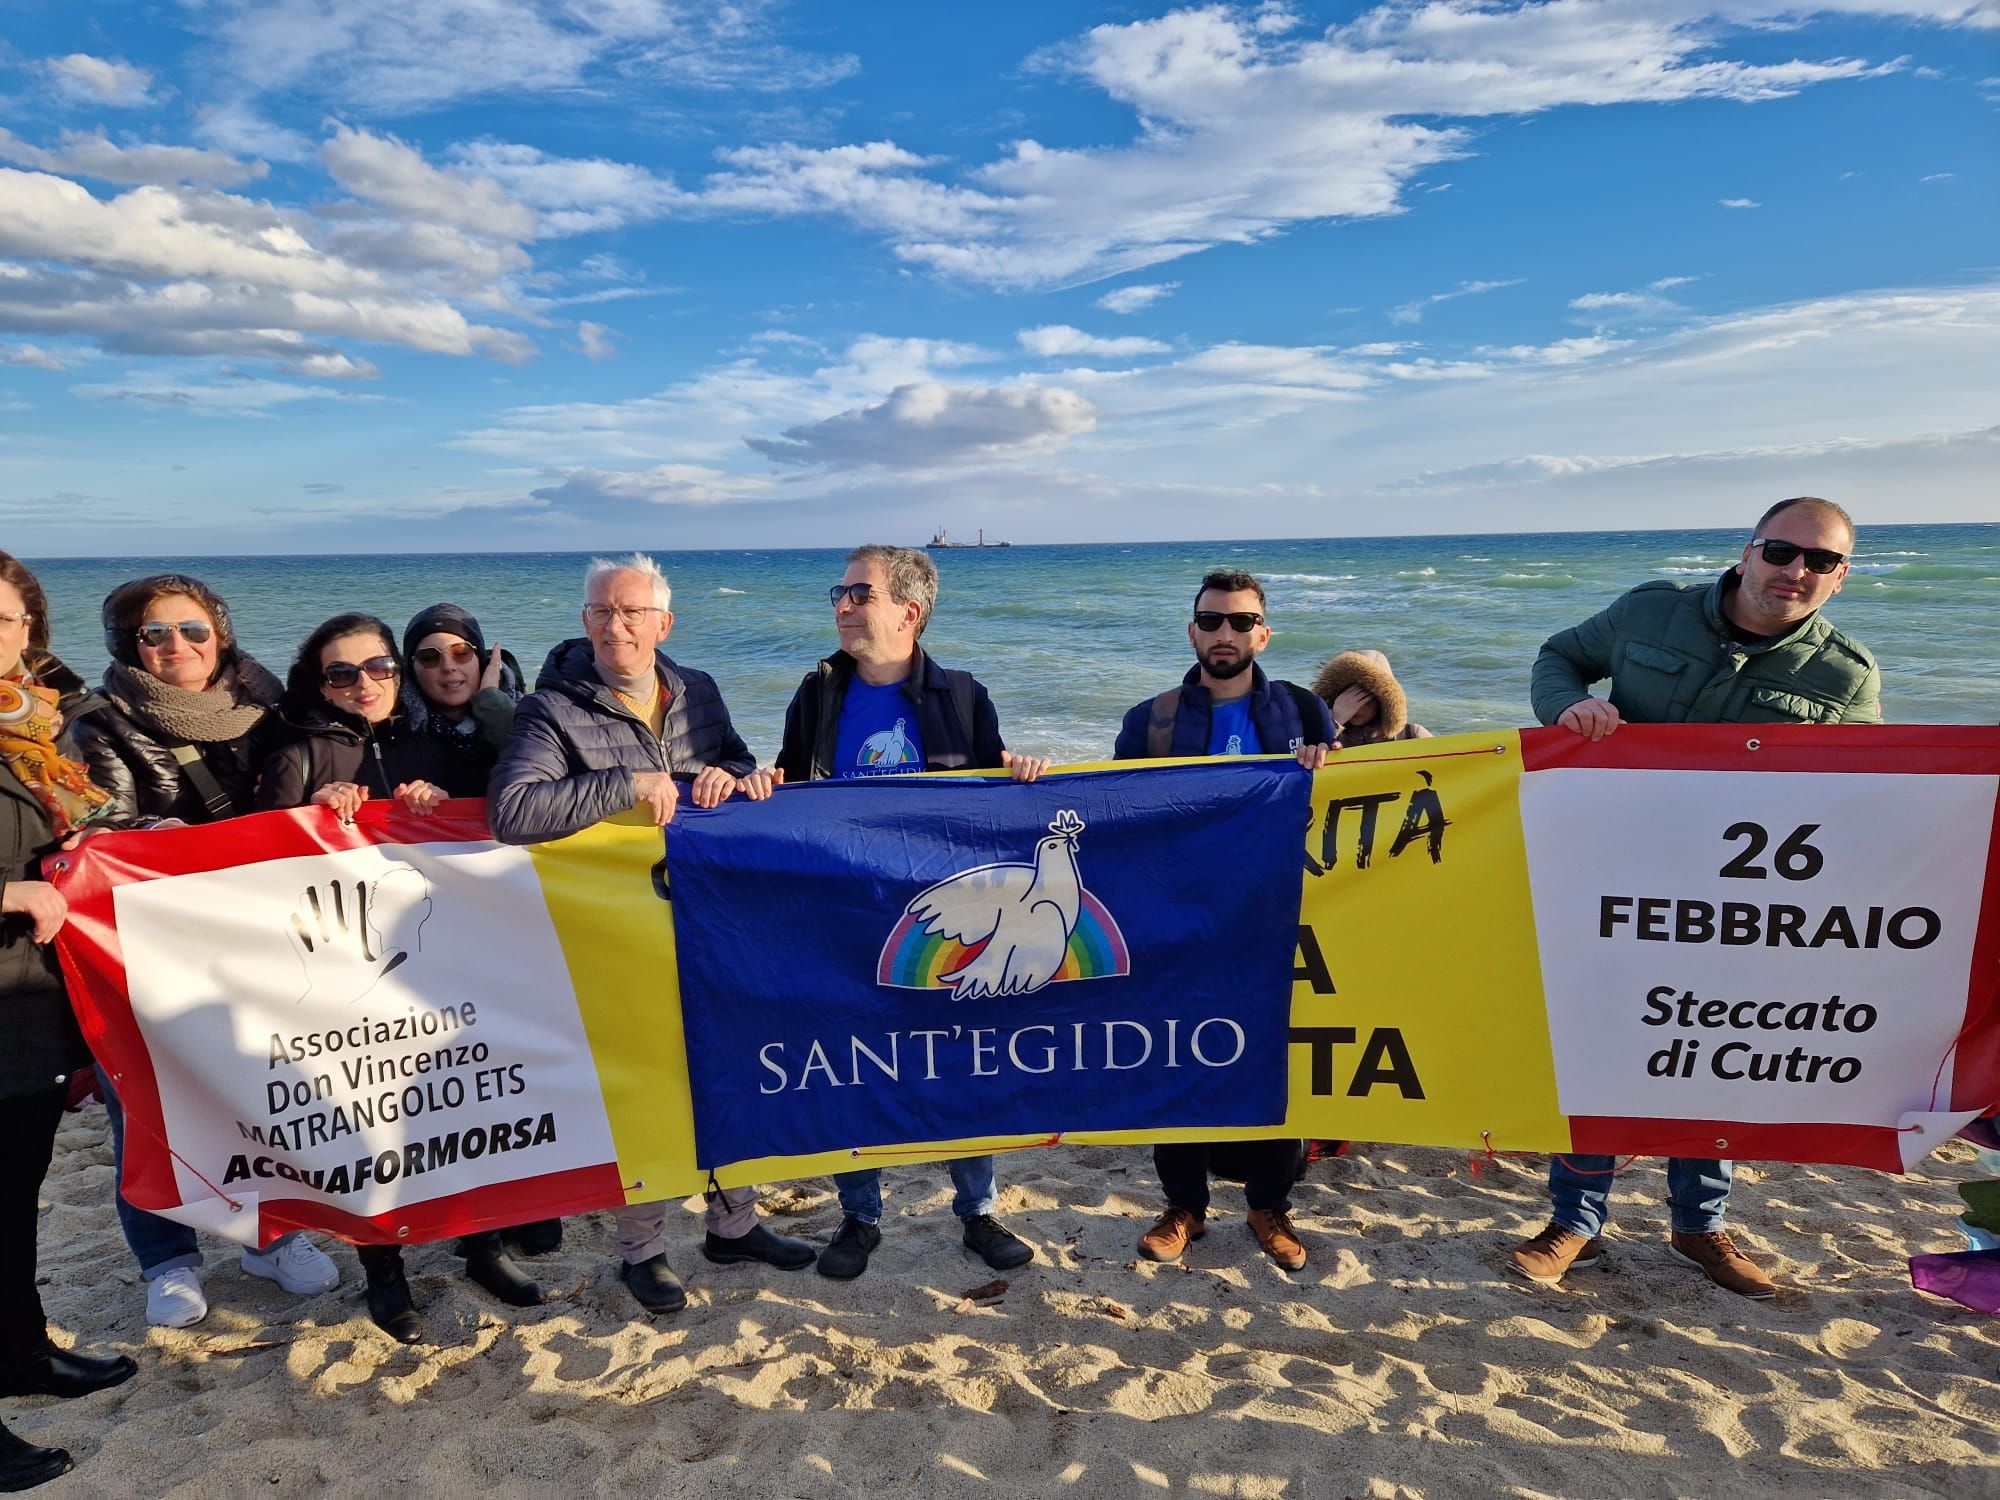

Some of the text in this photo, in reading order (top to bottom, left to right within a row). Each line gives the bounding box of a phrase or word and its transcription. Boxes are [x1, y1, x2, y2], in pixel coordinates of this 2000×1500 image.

[1718, 820, 1825, 882] 26
[1599, 895, 1943, 950] FEBBRAIO
[267, 1000, 478, 1071] Associazione
[1640, 985, 1879, 1034] Steccato
[265, 1041, 490, 1116] Don Vincenzo
[758, 1016, 1247, 1096] SANT'EGIDIO
[1646, 1038, 1863, 1084] di Cutro
[235, 1062, 526, 1152] MATRANGOLO ETS
[221, 1111, 558, 1195] ACQUAFORMORSA
